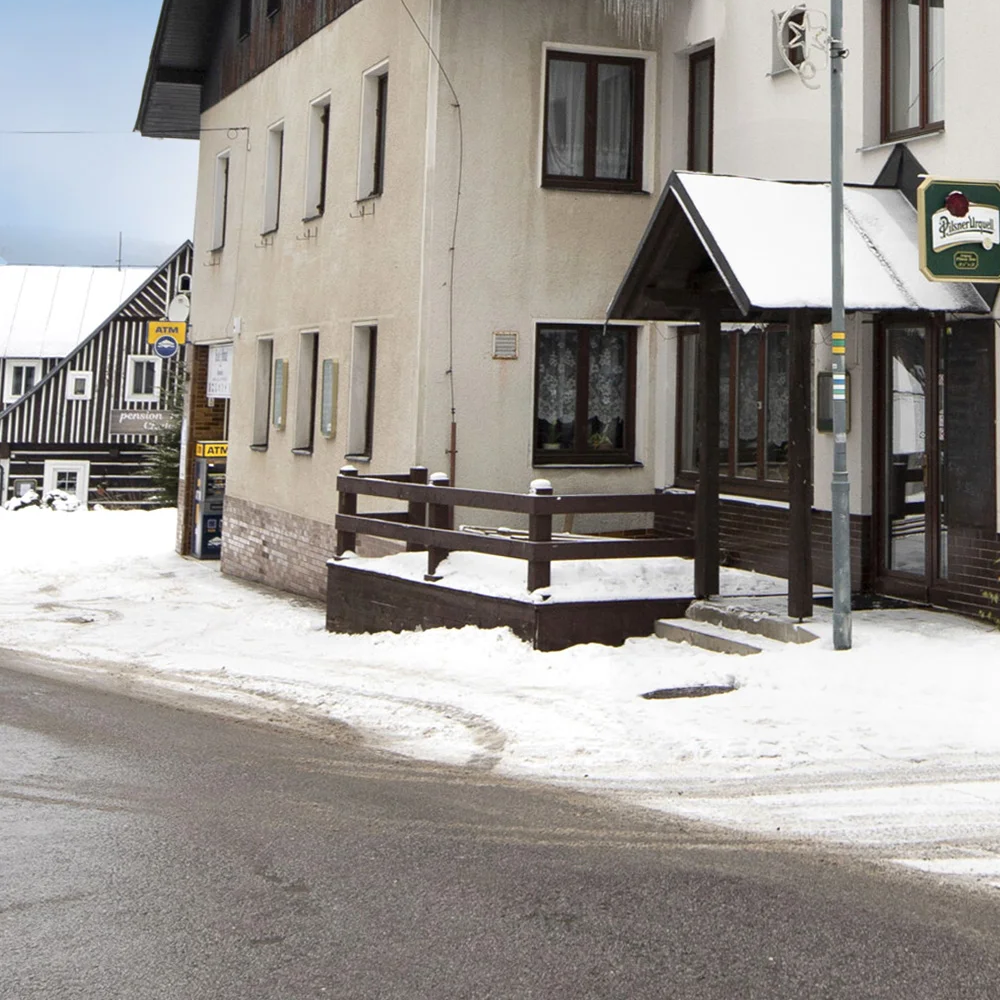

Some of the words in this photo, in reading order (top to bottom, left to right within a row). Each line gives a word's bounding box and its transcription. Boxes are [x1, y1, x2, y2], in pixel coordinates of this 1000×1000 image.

[938, 215, 969, 239] Pilsner
[155, 326, 179, 334] ATM
[119, 410, 163, 424] pension
